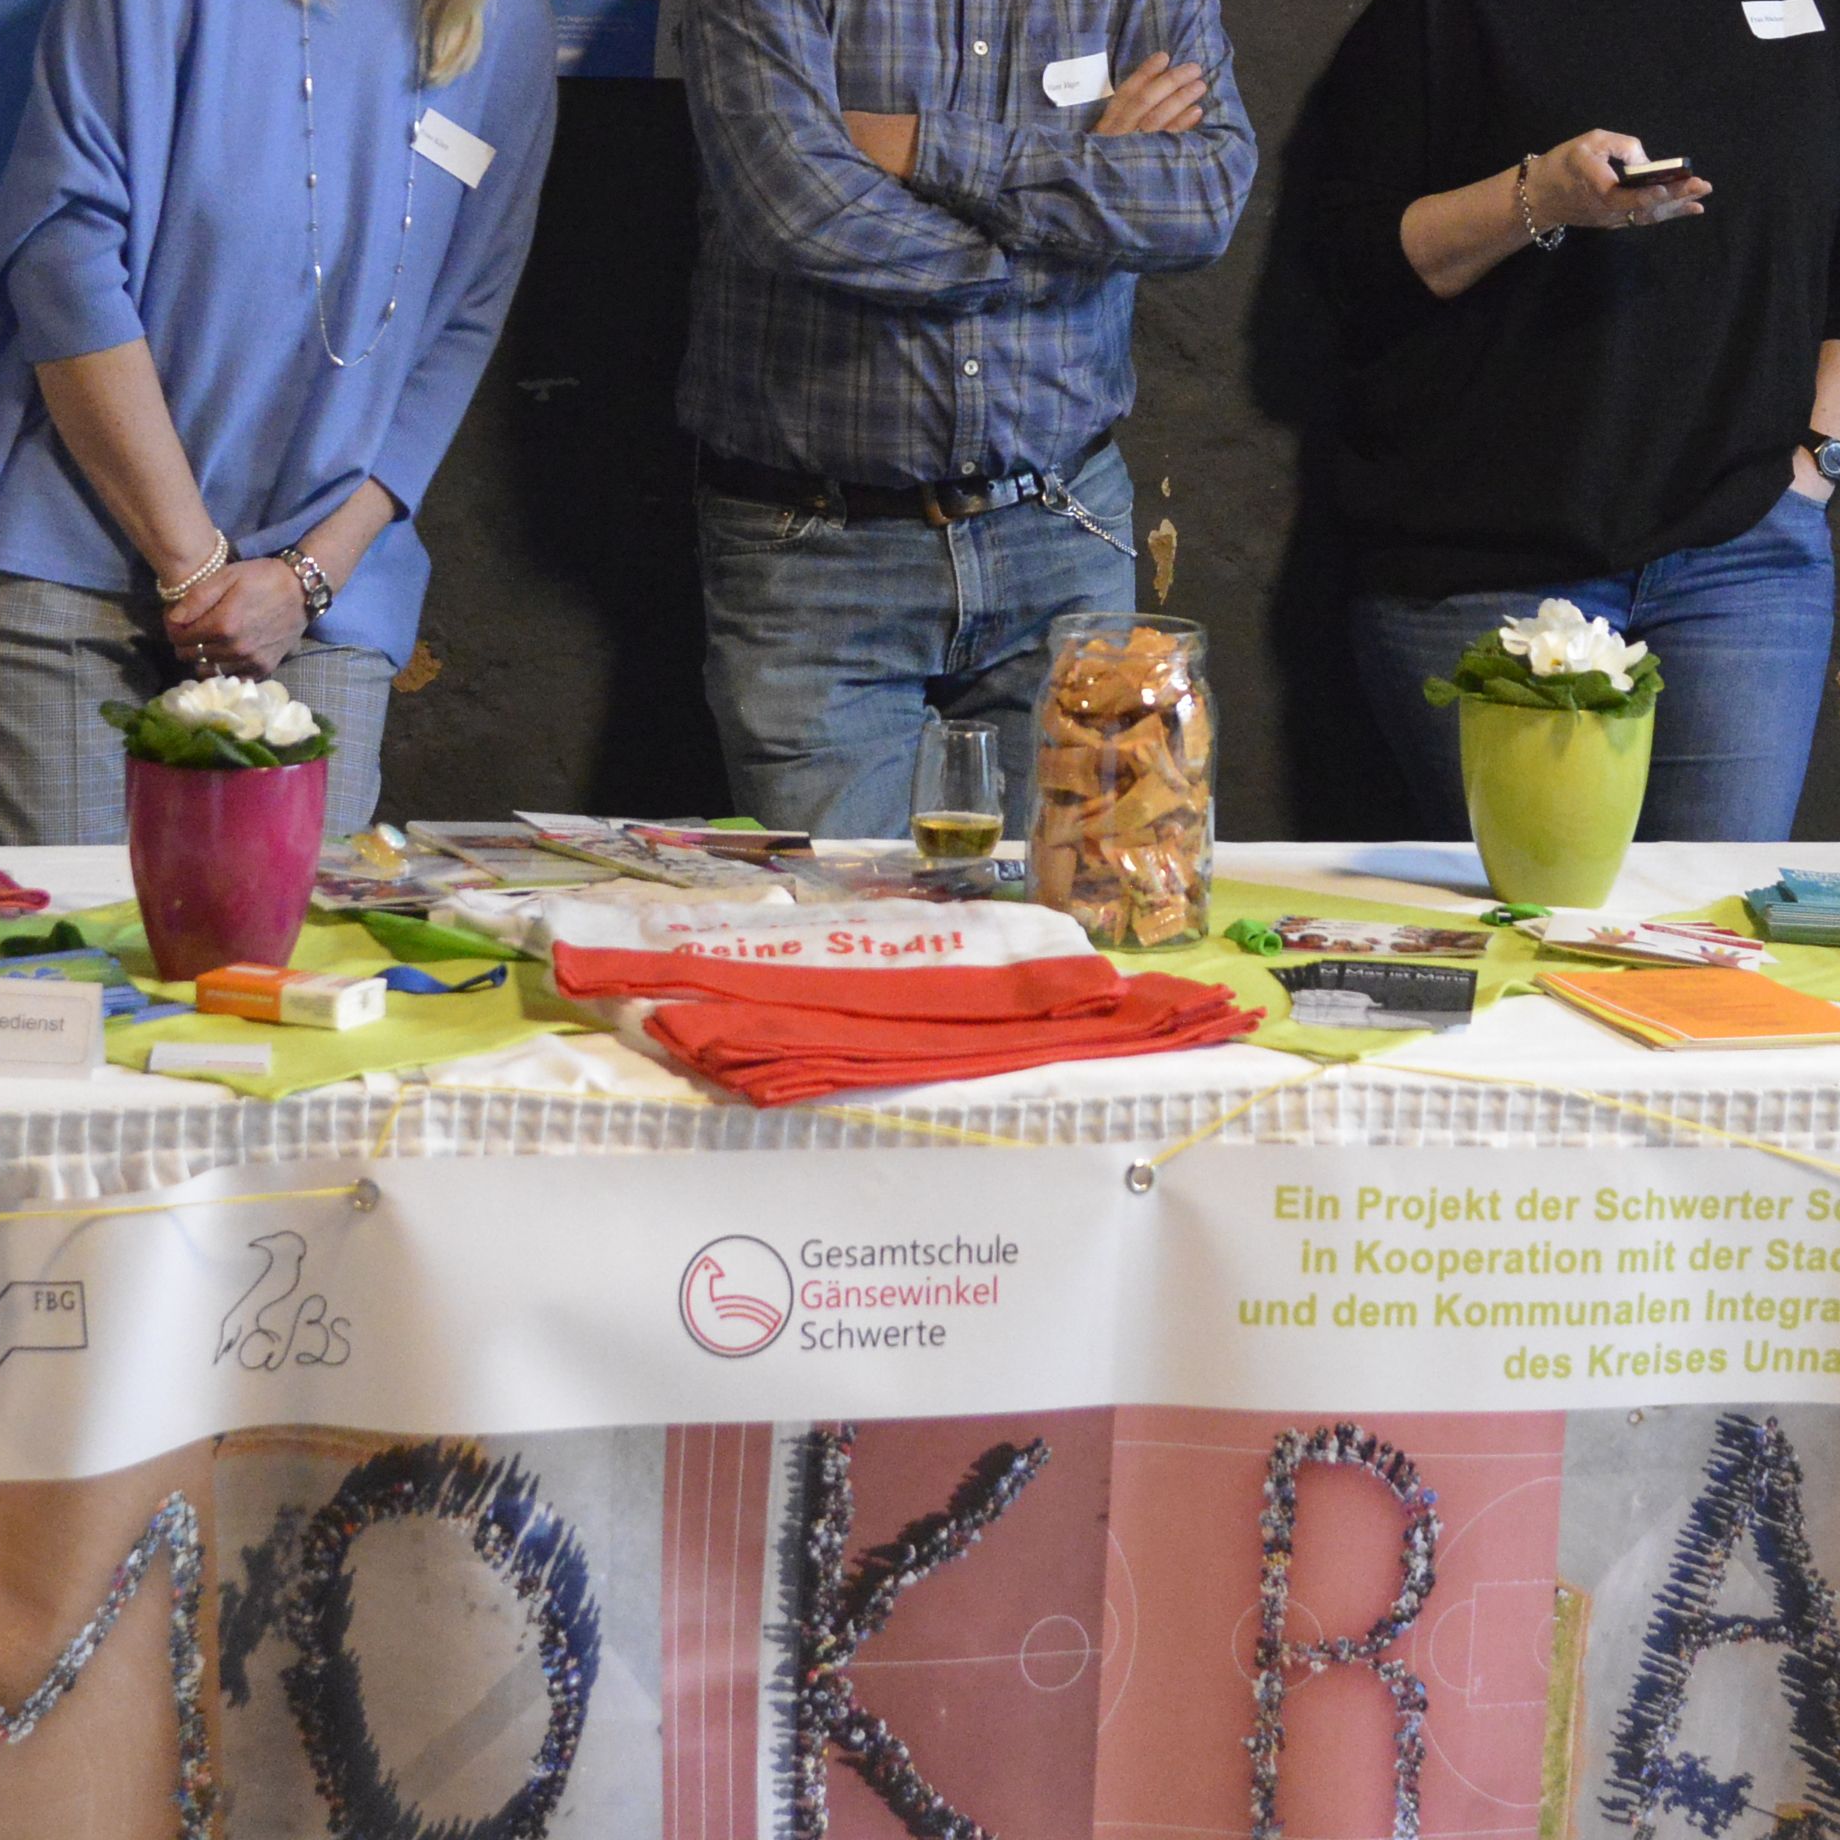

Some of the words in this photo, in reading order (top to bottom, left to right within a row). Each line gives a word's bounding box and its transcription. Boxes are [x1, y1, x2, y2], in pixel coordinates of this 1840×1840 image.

[826, 930, 964, 956] Stadt!
[1274, 1185, 1340, 1221] Ein
[1357, 1186, 1502, 1230] Projekt
[1515, 1188, 1580, 1221] der
[1594, 1187, 1794, 1222] Schwerter
[800, 1234, 1019, 1270] Gesamtschule
[1301, 1239, 1337, 1273] in
[1354, 1240, 1602, 1282] Kooperation
[1618, 1240, 1675, 1273] mit
[1689, 1238, 1752, 1271] der
[34, 1291, 75, 1312] FBG
[800, 1275, 999, 1311] Gänsewinkel
[1238, 1293, 1317, 1327] und
[1332, 1294, 1418, 1327] dem
[1434, 1292, 1690, 1327] Kommunalen
[800, 1320, 946, 1352] Schwerte
[1504, 1346, 1572, 1380] des
[1588, 1344, 1727, 1378] Kreises
